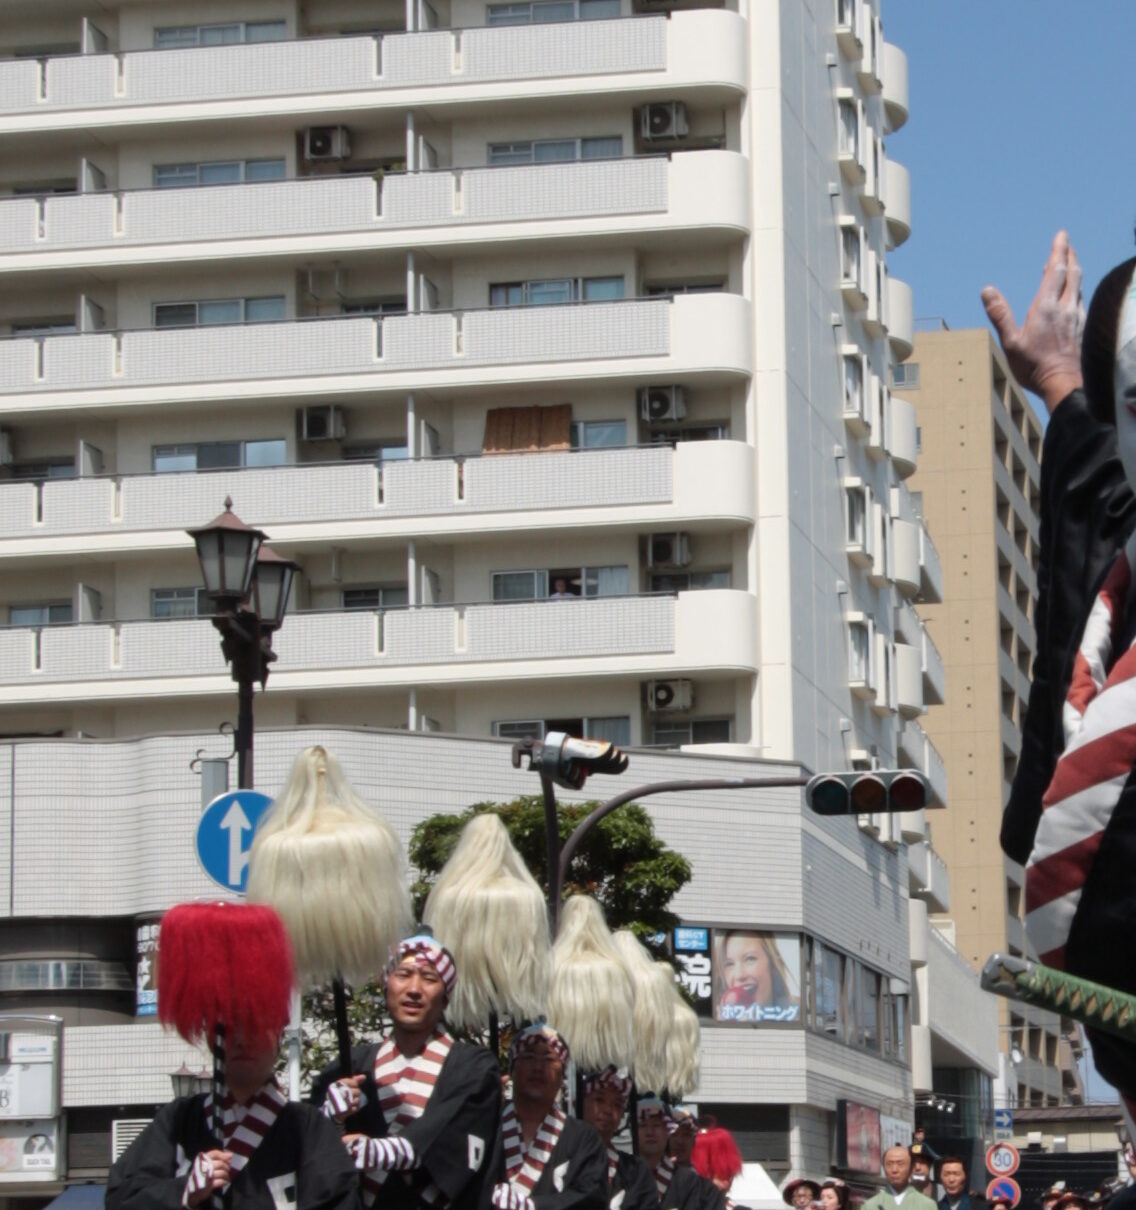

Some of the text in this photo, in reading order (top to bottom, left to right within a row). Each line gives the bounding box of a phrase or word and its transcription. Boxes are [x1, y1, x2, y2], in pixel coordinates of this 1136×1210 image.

[721, 1004, 799, 1021] ホワイトニング
[994, 1151, 1012, 1168] 30
